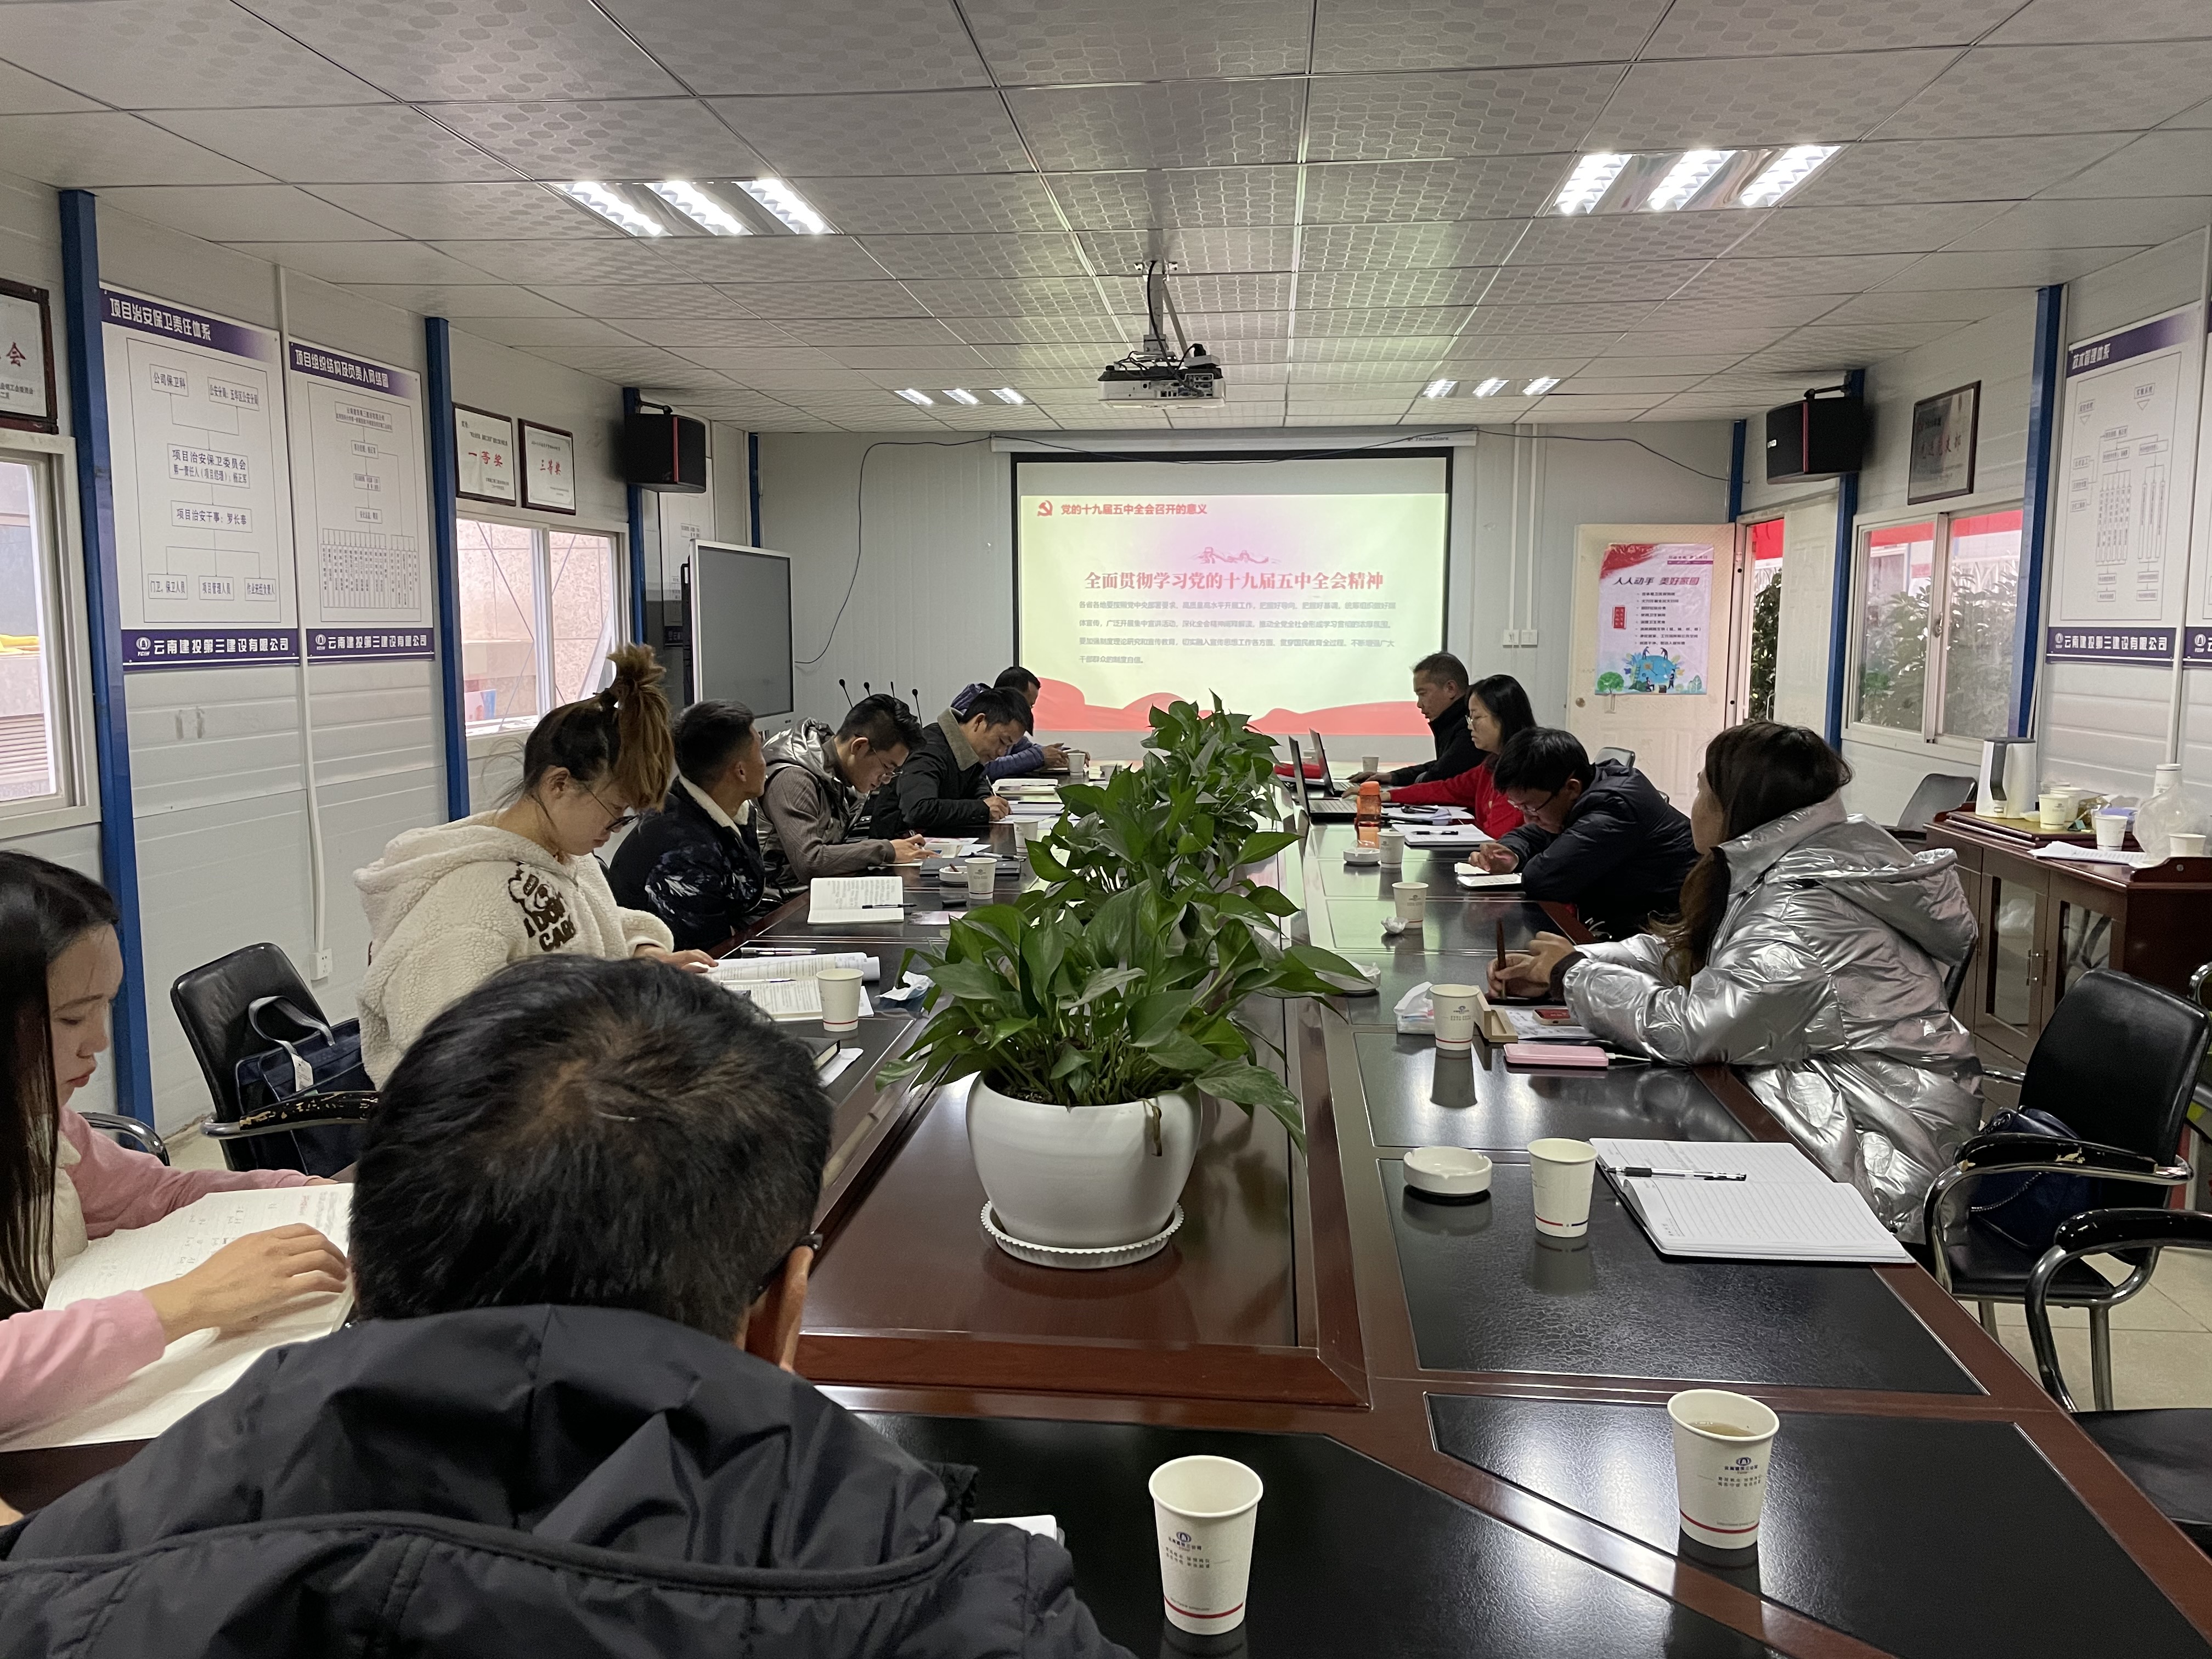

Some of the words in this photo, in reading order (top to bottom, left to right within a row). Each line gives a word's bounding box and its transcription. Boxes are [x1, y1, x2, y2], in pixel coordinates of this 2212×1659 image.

[110, 298, 211, 341] 项目治安保卫责任体系
[153, 372, 185, 390] 公司保卫科
[172, 449, 246, 471] 项目治安保卫委员会
[468, 451, 503, 468] 一等奖
[539, 459, 562, 476] 三等奖
[1061, 504, 1207, 515] 党的十九届五中全会召开的意义
[150, 580, 185, 594] 门卫、保卫人员
[202, 582, 231, 595] 项目管理人员
[1085, 571, 1384, 590] 全面贯彻学习党的十九届五中全会精神
[1612, 577, 1655, 585] 人人动手
[1658, 577, 1700, 585] 美好家园
[154, 637, 289, 655] 云南建投第三建设有限公司
[328, 634, 427, 649] 云南建投第三建设有限公司
